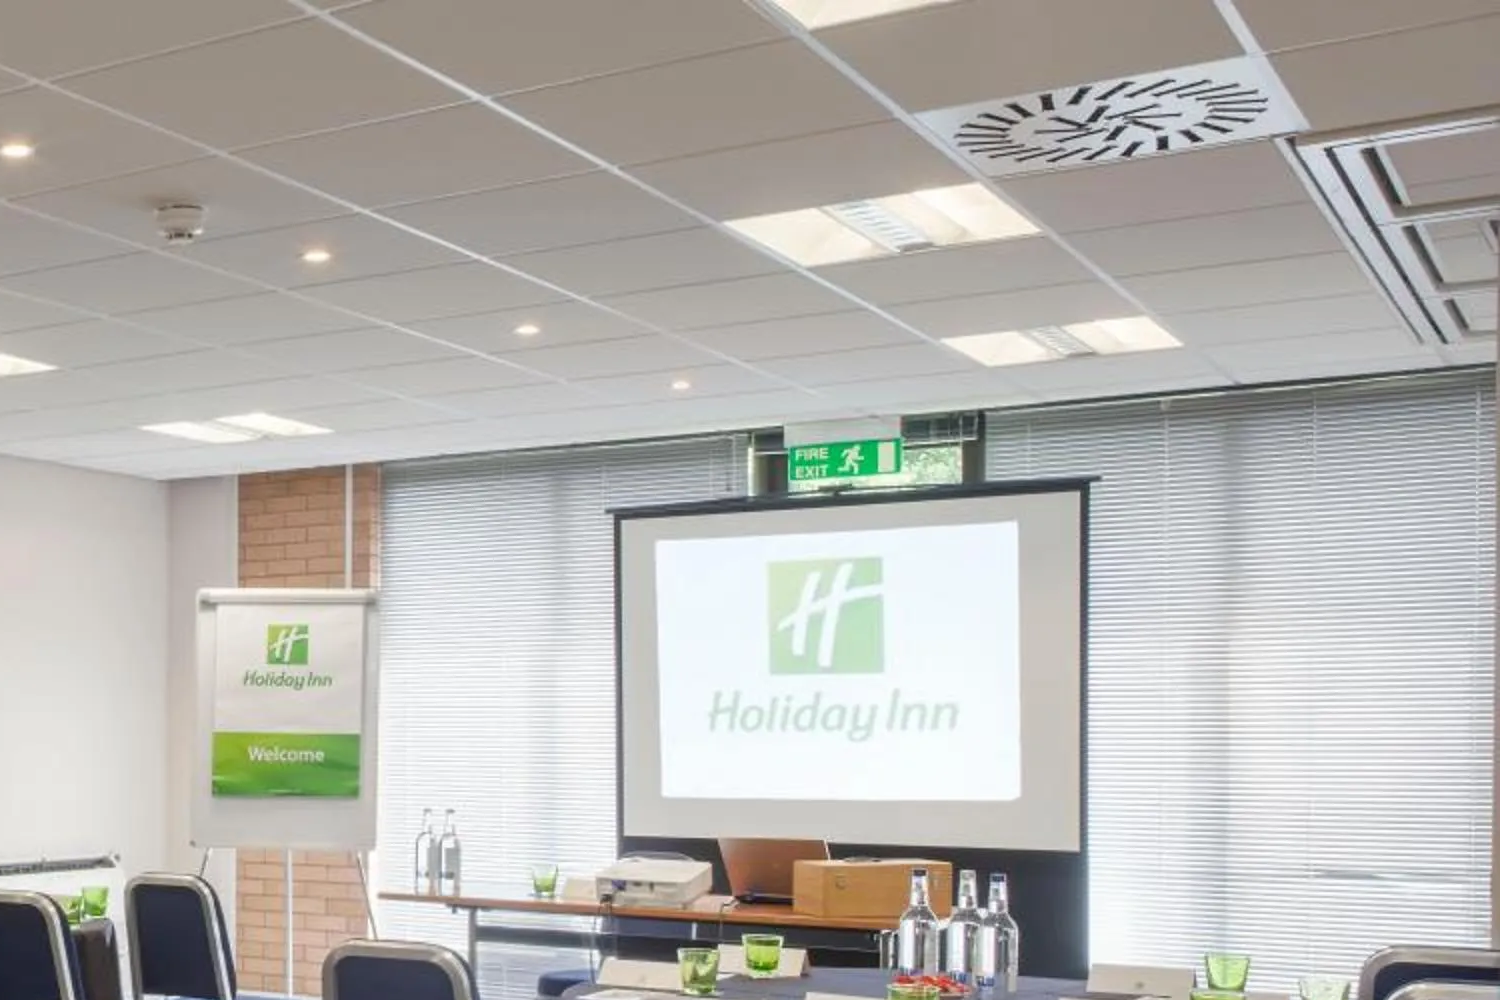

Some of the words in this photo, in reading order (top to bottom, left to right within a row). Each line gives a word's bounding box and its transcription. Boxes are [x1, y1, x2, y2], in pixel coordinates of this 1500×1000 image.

[795, 447, 829, 462] FIRE
[795, 464, 829, 479] EXIT
[243, 671, 306, 691] Holiday
[307, 671, 333, 687] Inn
[708, 689, 879, 742] Holiday
[885, 687, 960, 731] Inn
[247, 745, 325, 762] Welcome
